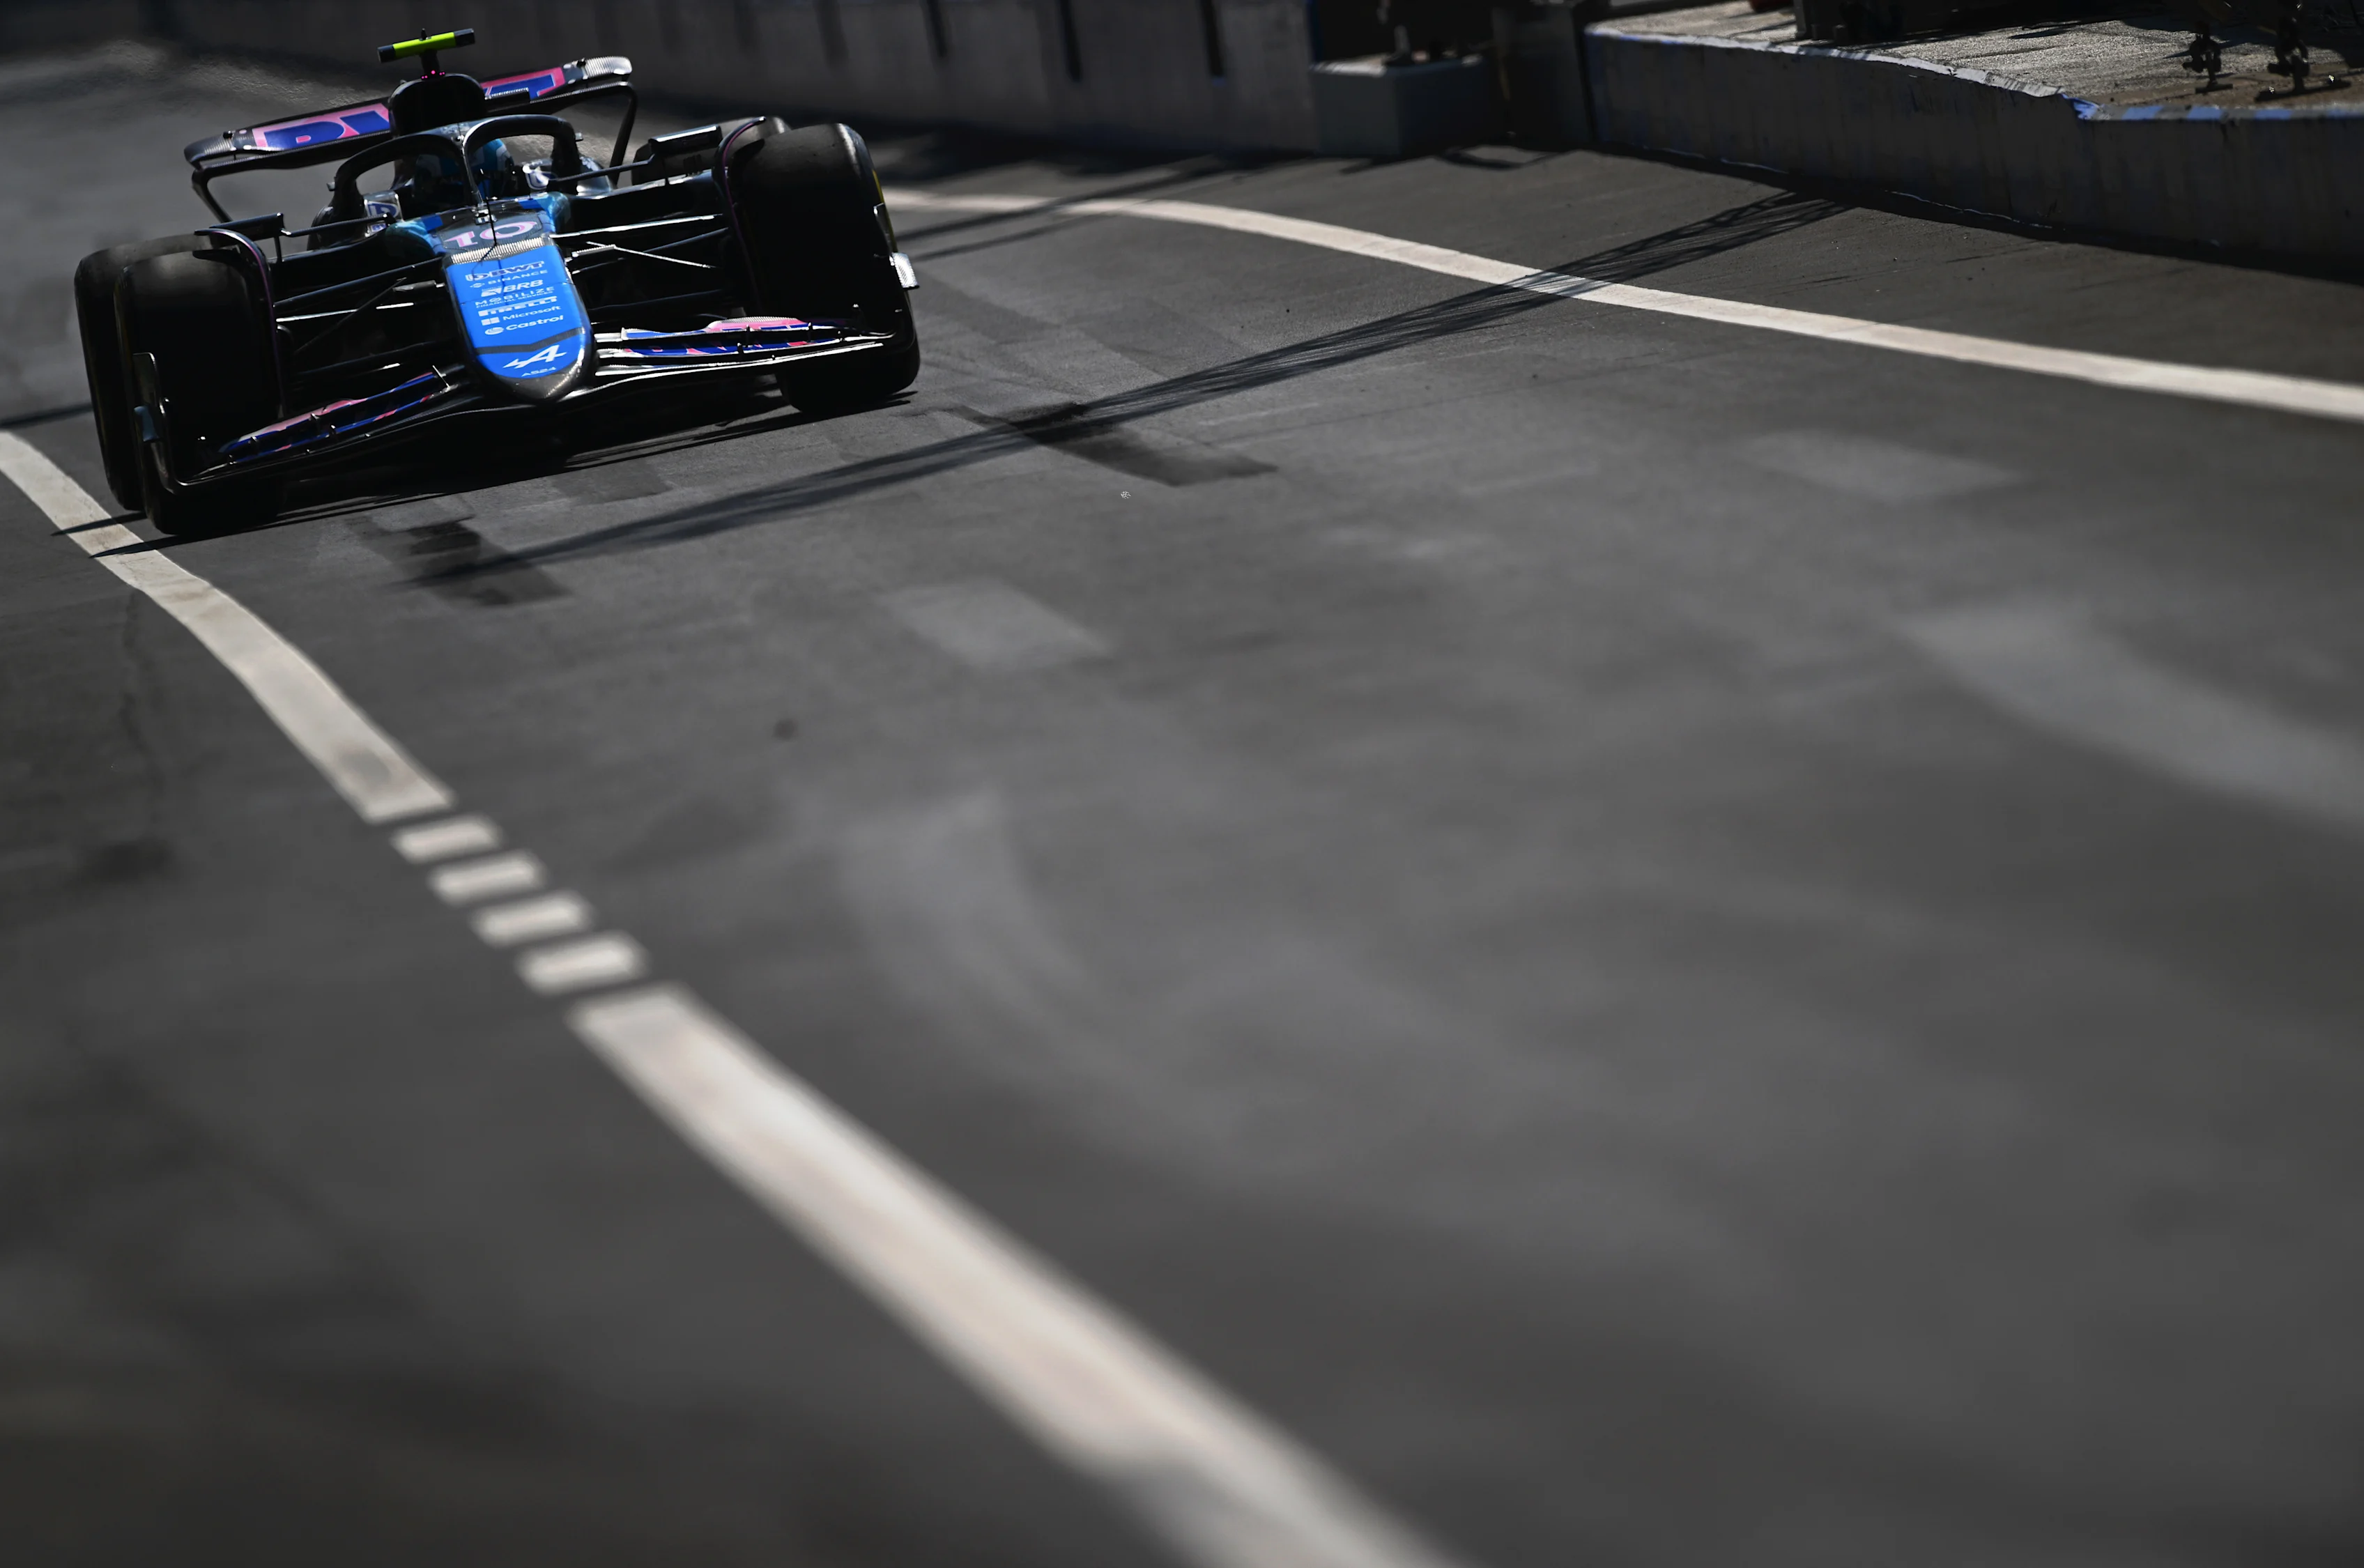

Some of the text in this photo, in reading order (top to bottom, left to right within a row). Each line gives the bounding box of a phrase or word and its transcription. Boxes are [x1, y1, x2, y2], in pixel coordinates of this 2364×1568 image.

[444, 221, 538, 247] 10
[489, 261, 544, 277] BWT
[488, 270, 548, 284] BINANCE
[503, 279, 543, 293] BRB
[478, 296, 558, 316] PIRELLI
[503, 306, 561, 321] Microsoft
[506, 315, 564, 330] Castrol
